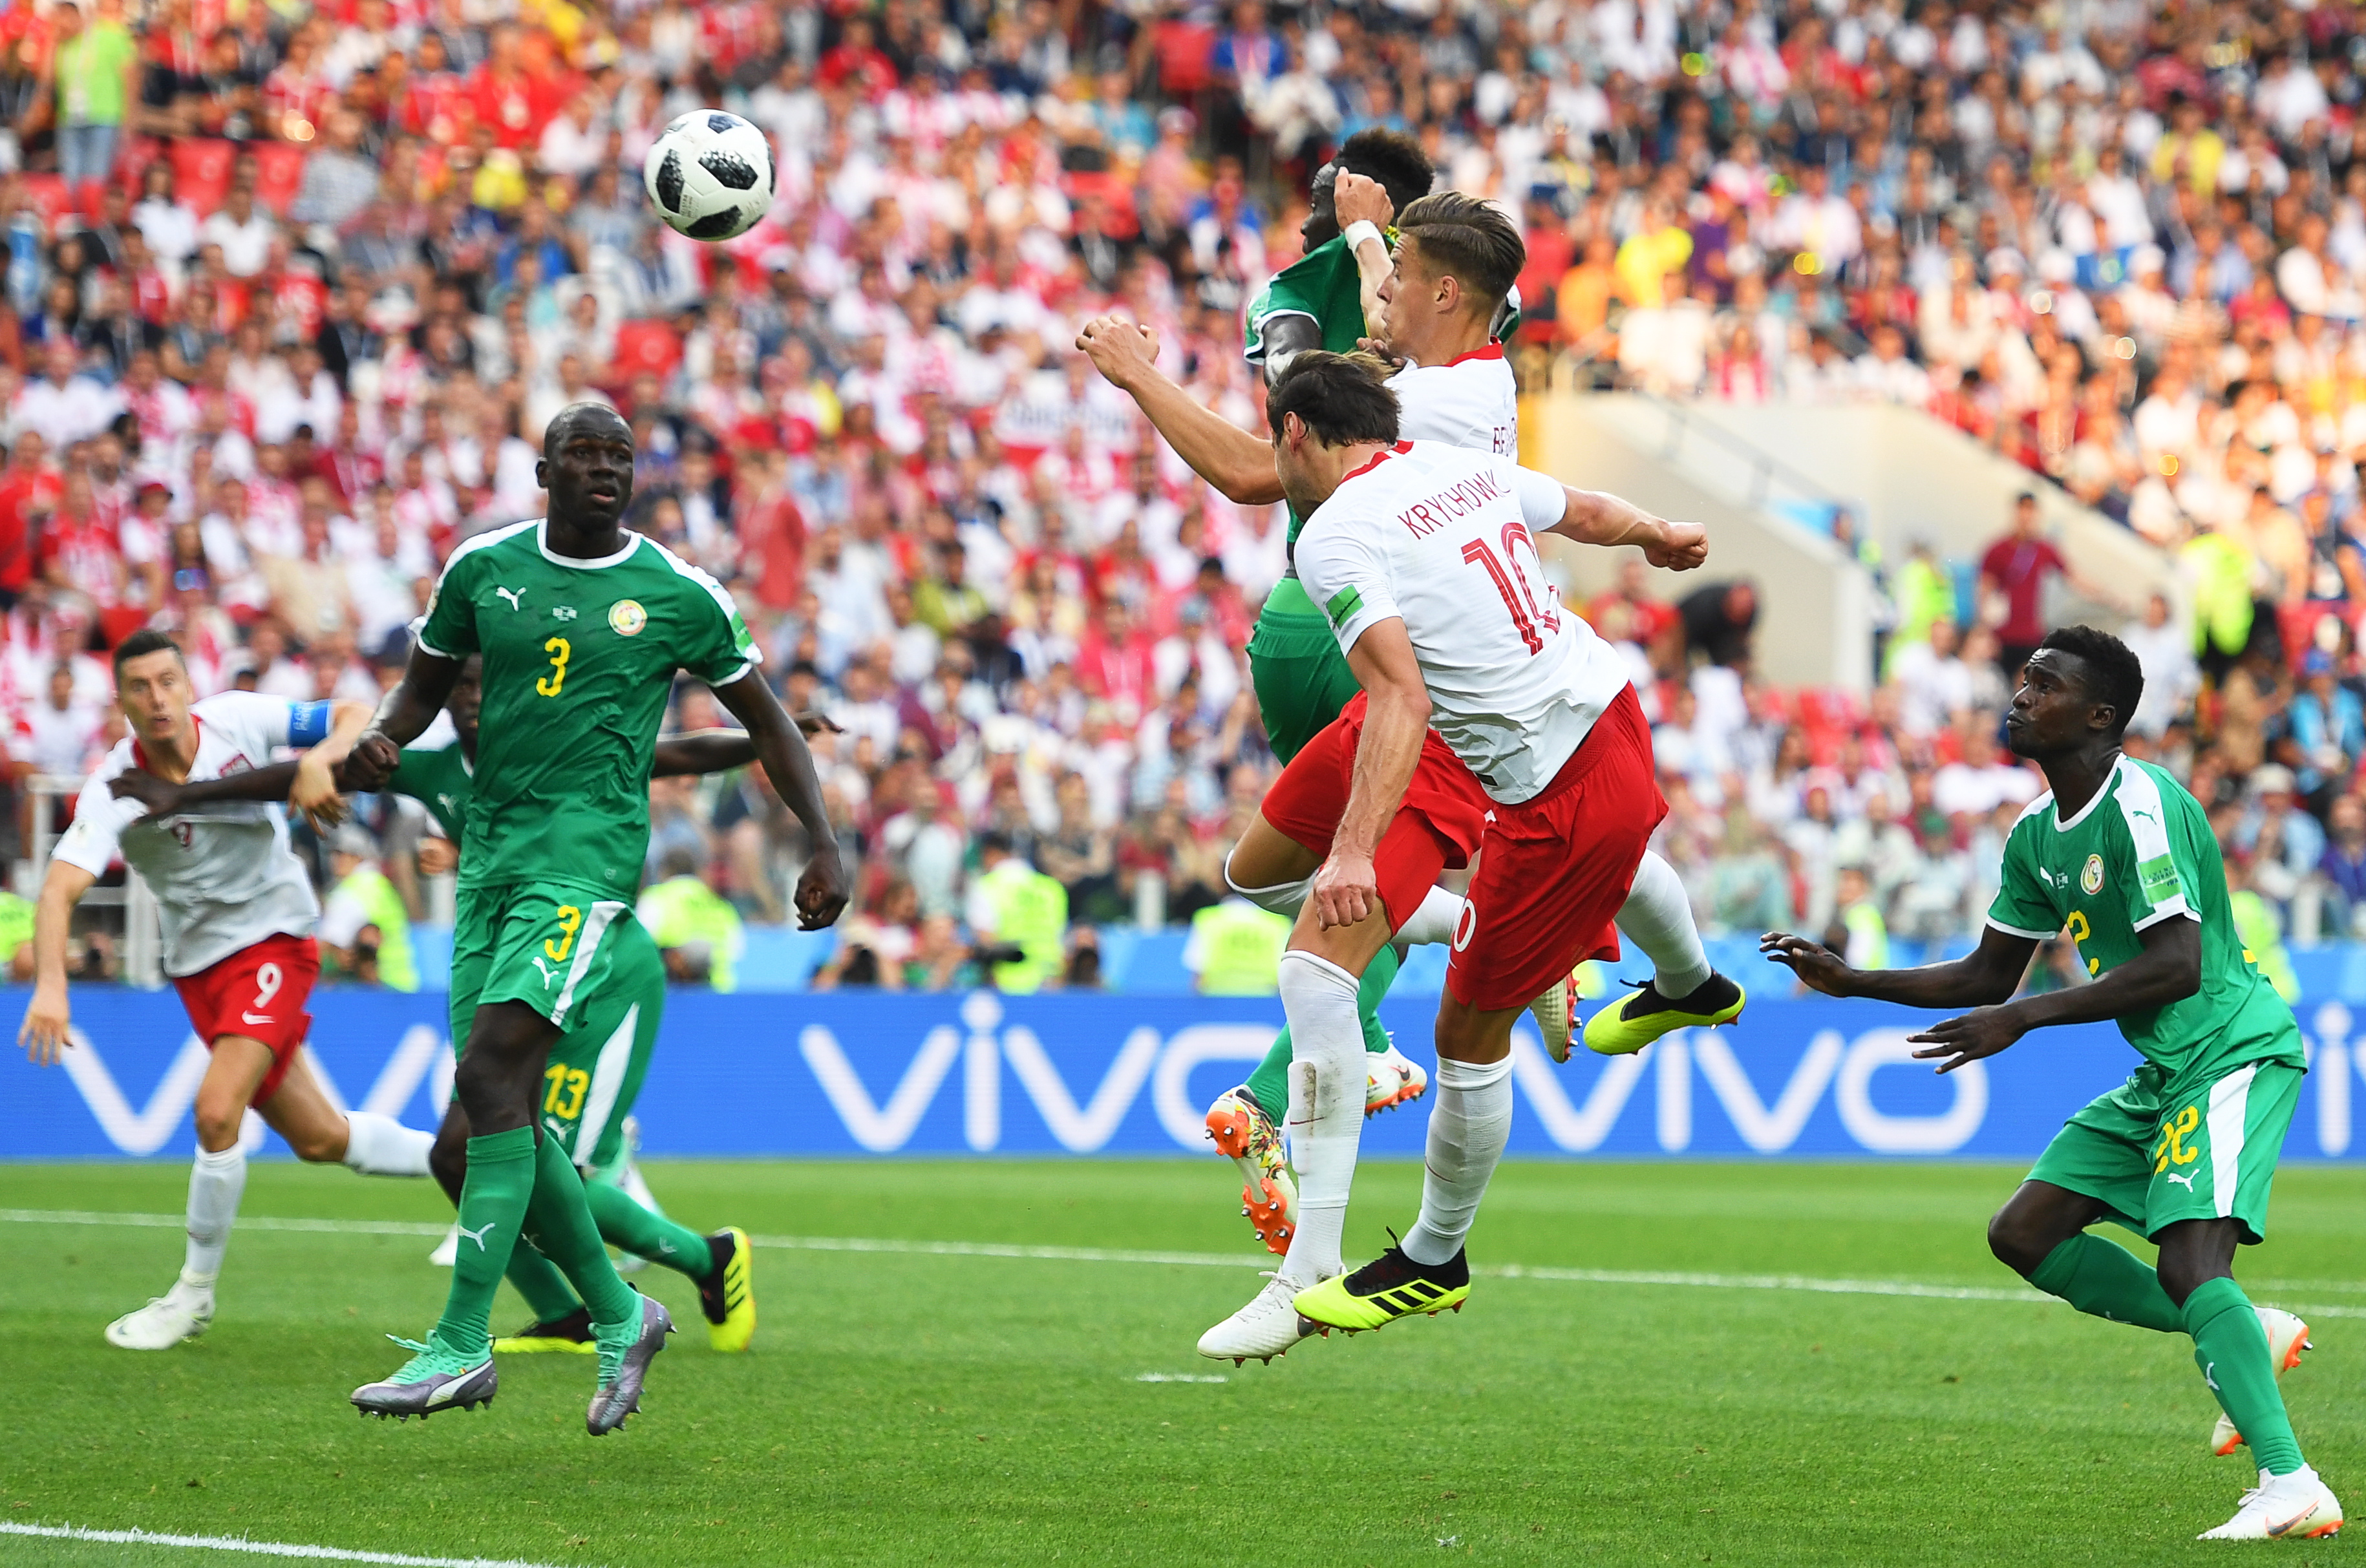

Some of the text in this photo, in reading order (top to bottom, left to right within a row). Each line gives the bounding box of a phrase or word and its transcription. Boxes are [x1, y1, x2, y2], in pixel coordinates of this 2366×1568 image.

[1460, 522, 1561, 657] 10
[536, 637, 570, 697] 3
[544, 905, 581, 962] 3
[253, 962, 283, 1008] 9
[544, 1063, 590, 1120] 13
[2154, 1106, 2199, 1176] 22
